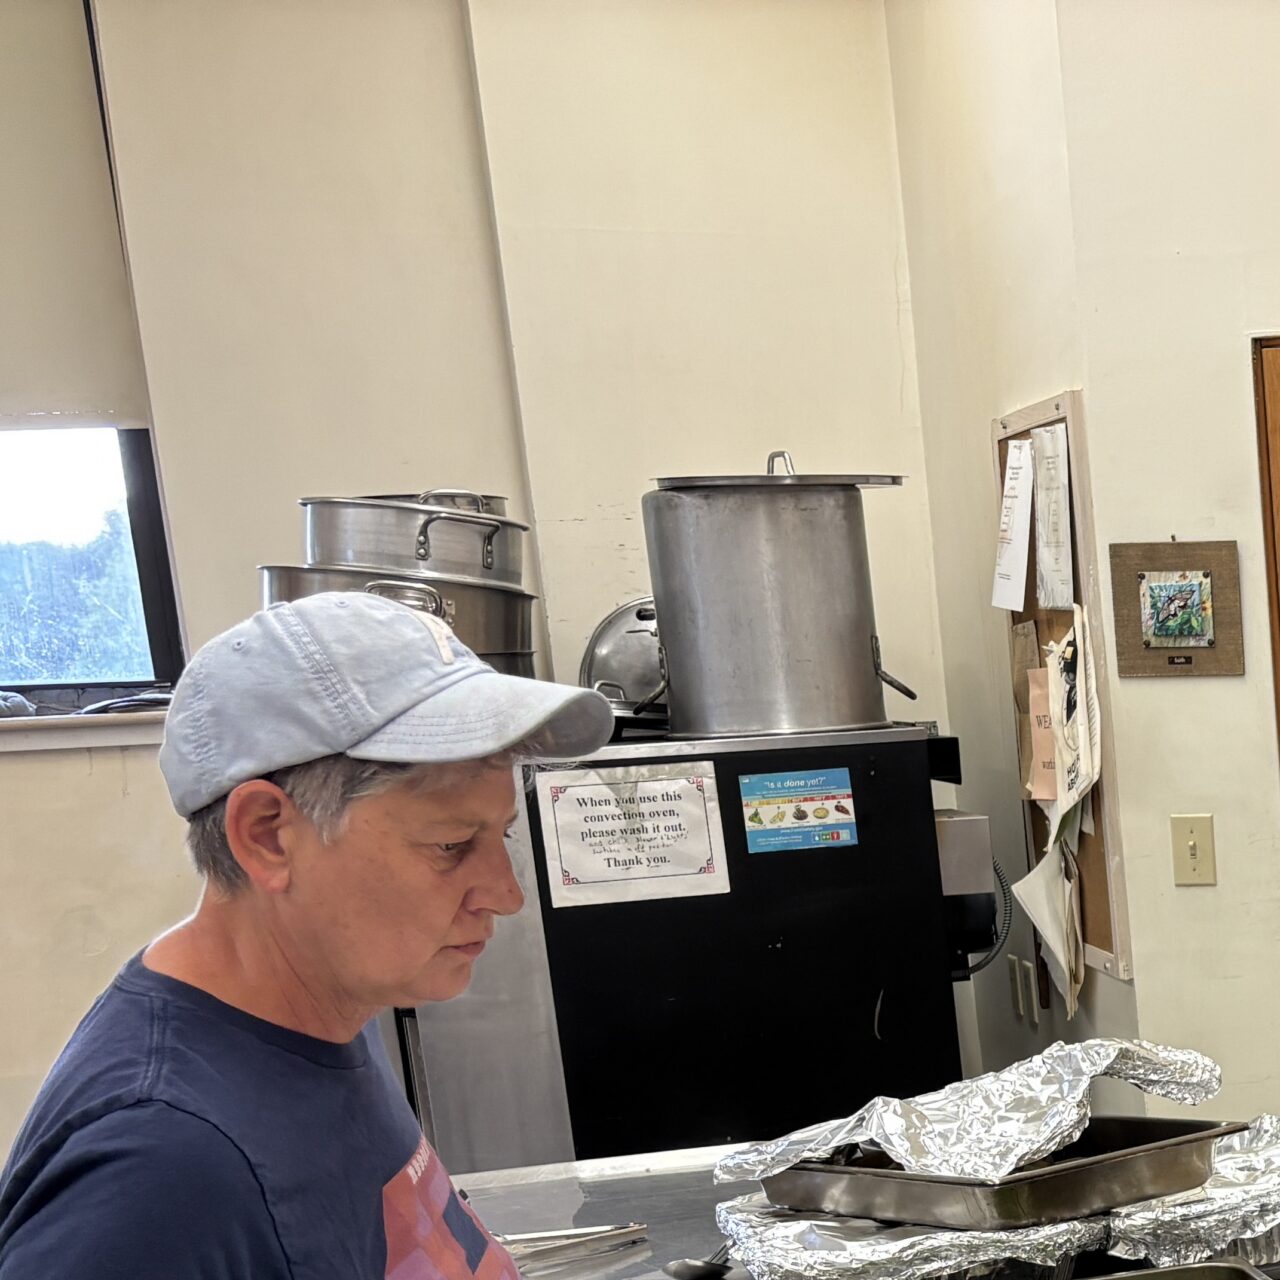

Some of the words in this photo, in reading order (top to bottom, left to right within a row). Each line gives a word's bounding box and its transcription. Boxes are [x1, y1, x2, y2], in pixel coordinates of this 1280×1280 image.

[576, 797, 611, 809] When
[614, 796, 636, 808] you
[639, 795, 658, 804] use
[661, 791, 682, 802] this
[583, 810, 645, 823] convection
[649, 808, 680, 819] oven,
[581, 827, 617, 841] please
[619, 824, 648, 835] wash
[652, 822, 661, 833] it
[664, 823, 686, 833] out.
[603, 854, 643, 868] Thank
[646, 855, 671, 868] you.
